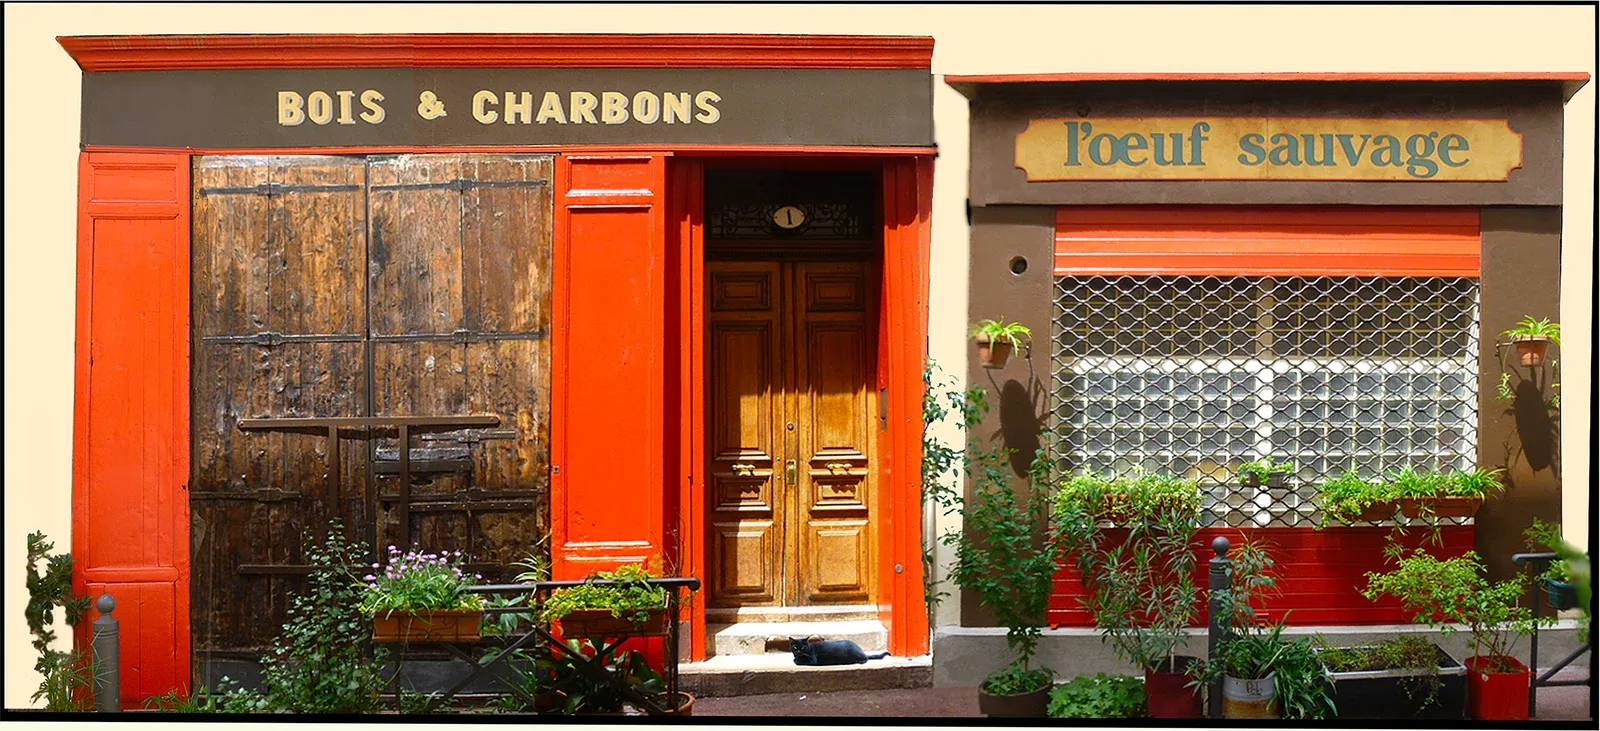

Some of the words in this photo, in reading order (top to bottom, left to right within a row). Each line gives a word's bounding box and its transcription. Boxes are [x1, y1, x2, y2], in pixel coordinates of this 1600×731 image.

[277, 90, 386, 126] BOIS
[417, 90, 446, 120] &
[472, 89, 723, 126] CHARBONS
[1237, 130, 1470, 179] sauvage
[786, 208, 794, 225] 1
